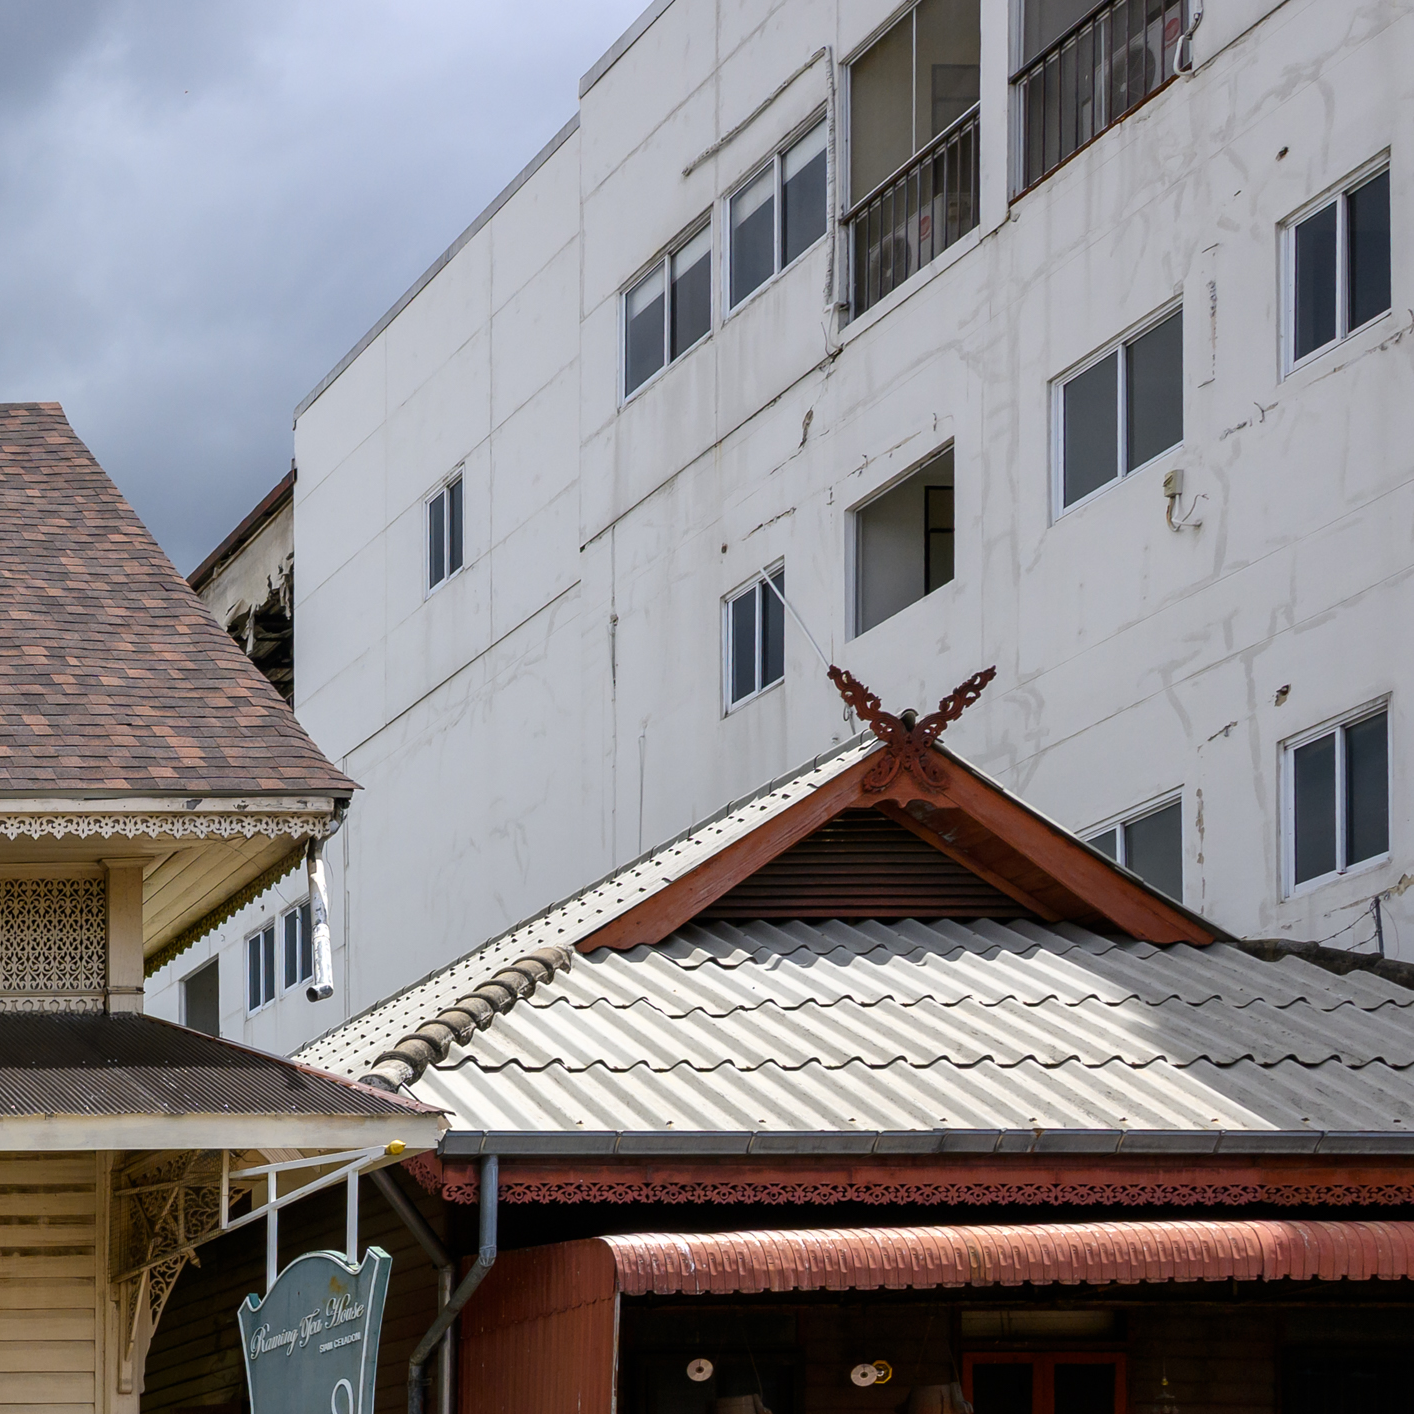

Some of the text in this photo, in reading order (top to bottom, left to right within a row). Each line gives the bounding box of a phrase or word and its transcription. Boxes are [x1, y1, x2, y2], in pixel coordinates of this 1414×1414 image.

[250, 1293, 365, 1360] Raming Tea House
[319, 1331, 362, 1354] SIAM CELADON
